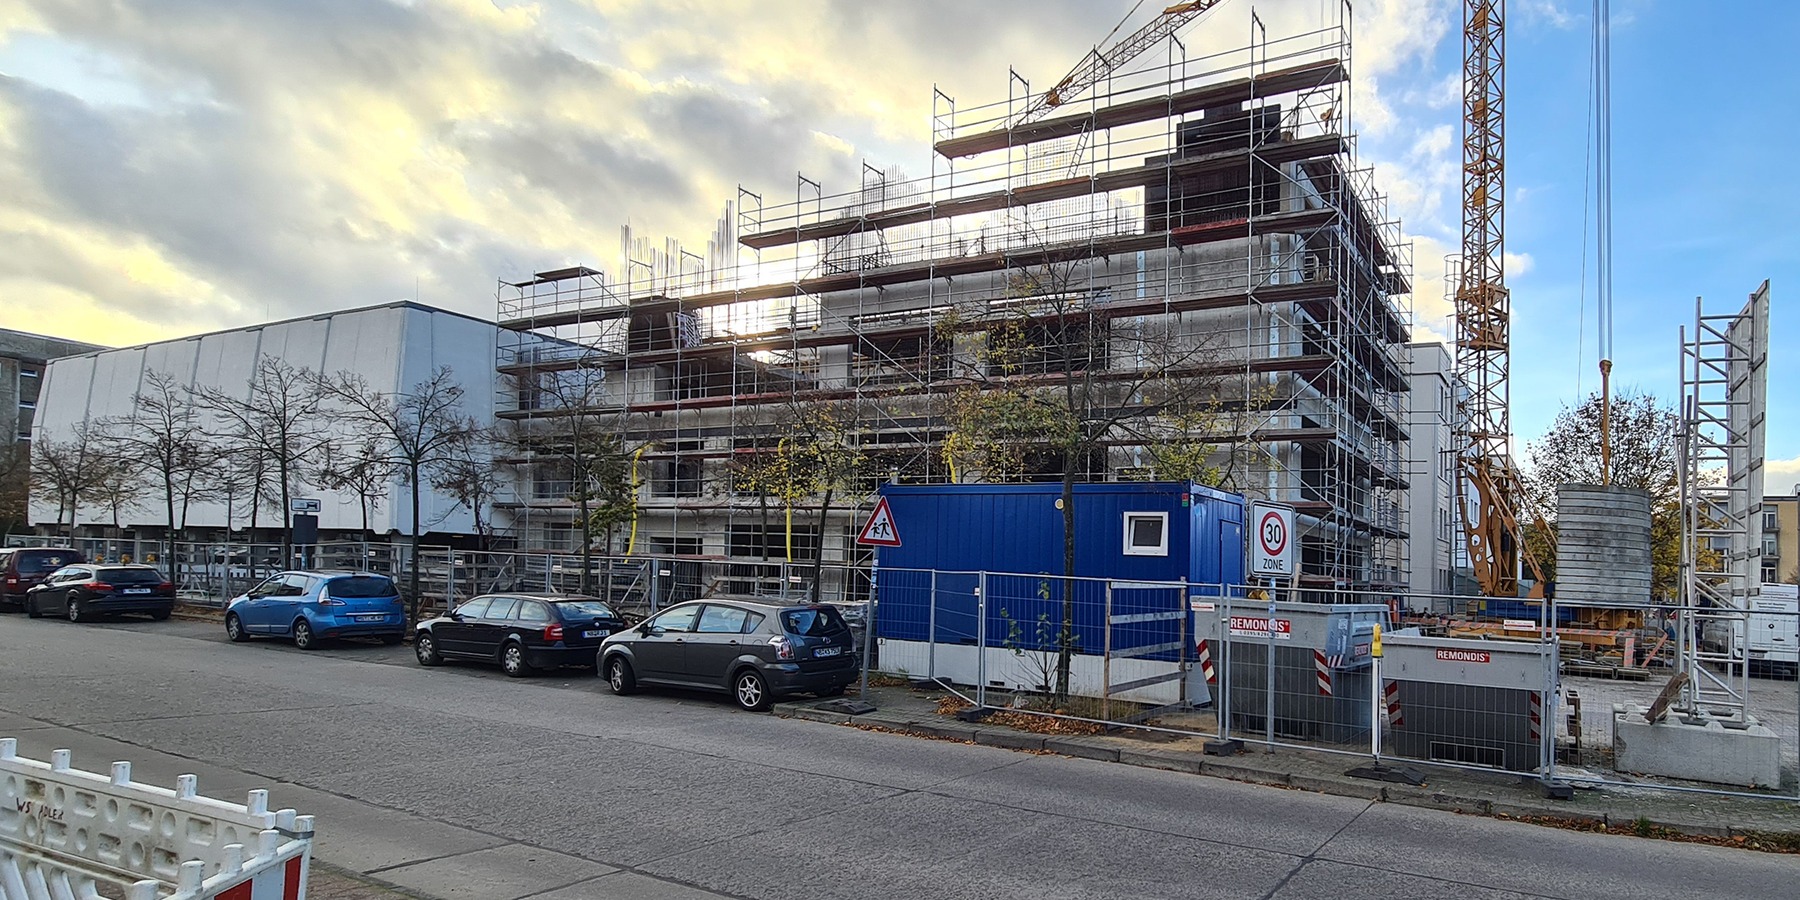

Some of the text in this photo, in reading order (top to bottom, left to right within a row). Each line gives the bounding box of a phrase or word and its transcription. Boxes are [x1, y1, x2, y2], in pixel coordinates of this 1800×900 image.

[1265, 523, 1281, 545] 30
[1263, 558, 1283, 571] ZONE
[1230, 617, 1285, 632] REMONIS
[1437, 650, 1486, 662] REMONDIS
[16, 797, 32, 813] WS
